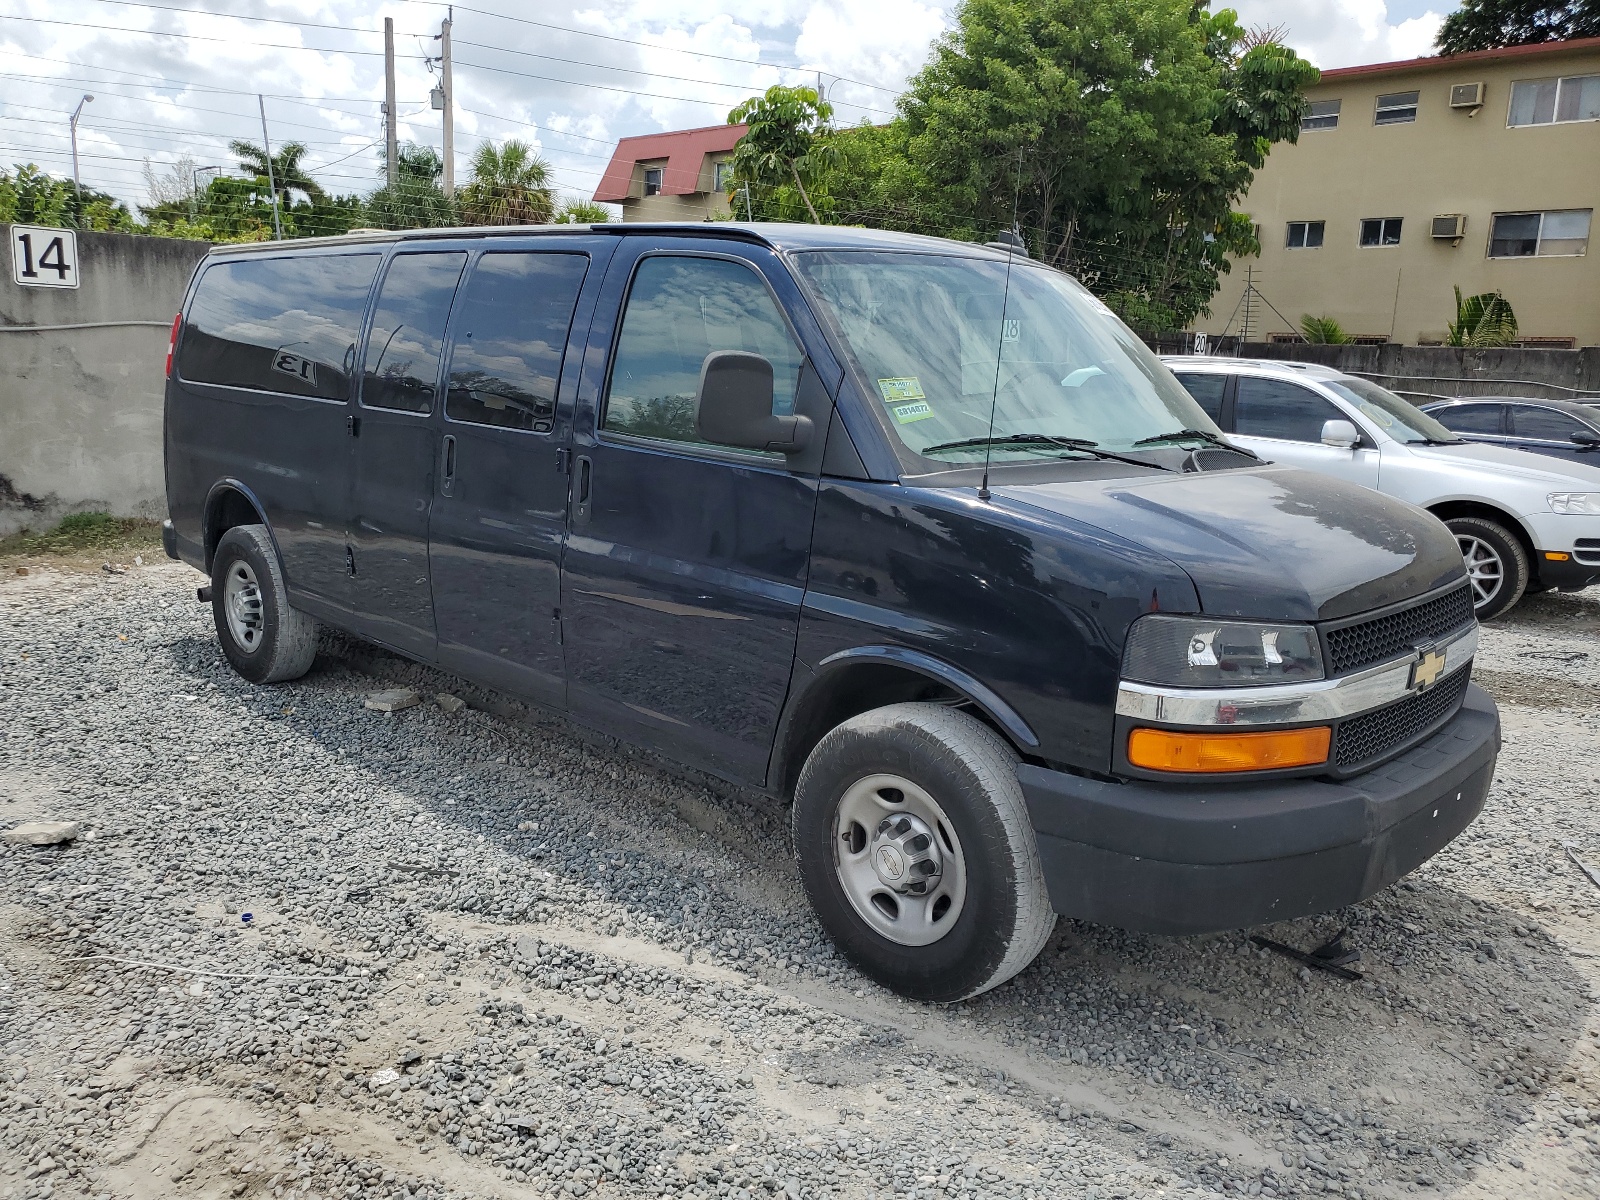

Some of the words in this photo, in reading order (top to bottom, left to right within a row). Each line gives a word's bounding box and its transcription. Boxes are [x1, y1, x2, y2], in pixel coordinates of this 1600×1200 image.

[18, 233, 71, 280] 14
[1005, 319, 1018, 338] 18
[1195, 335, 1205, 353] 20
